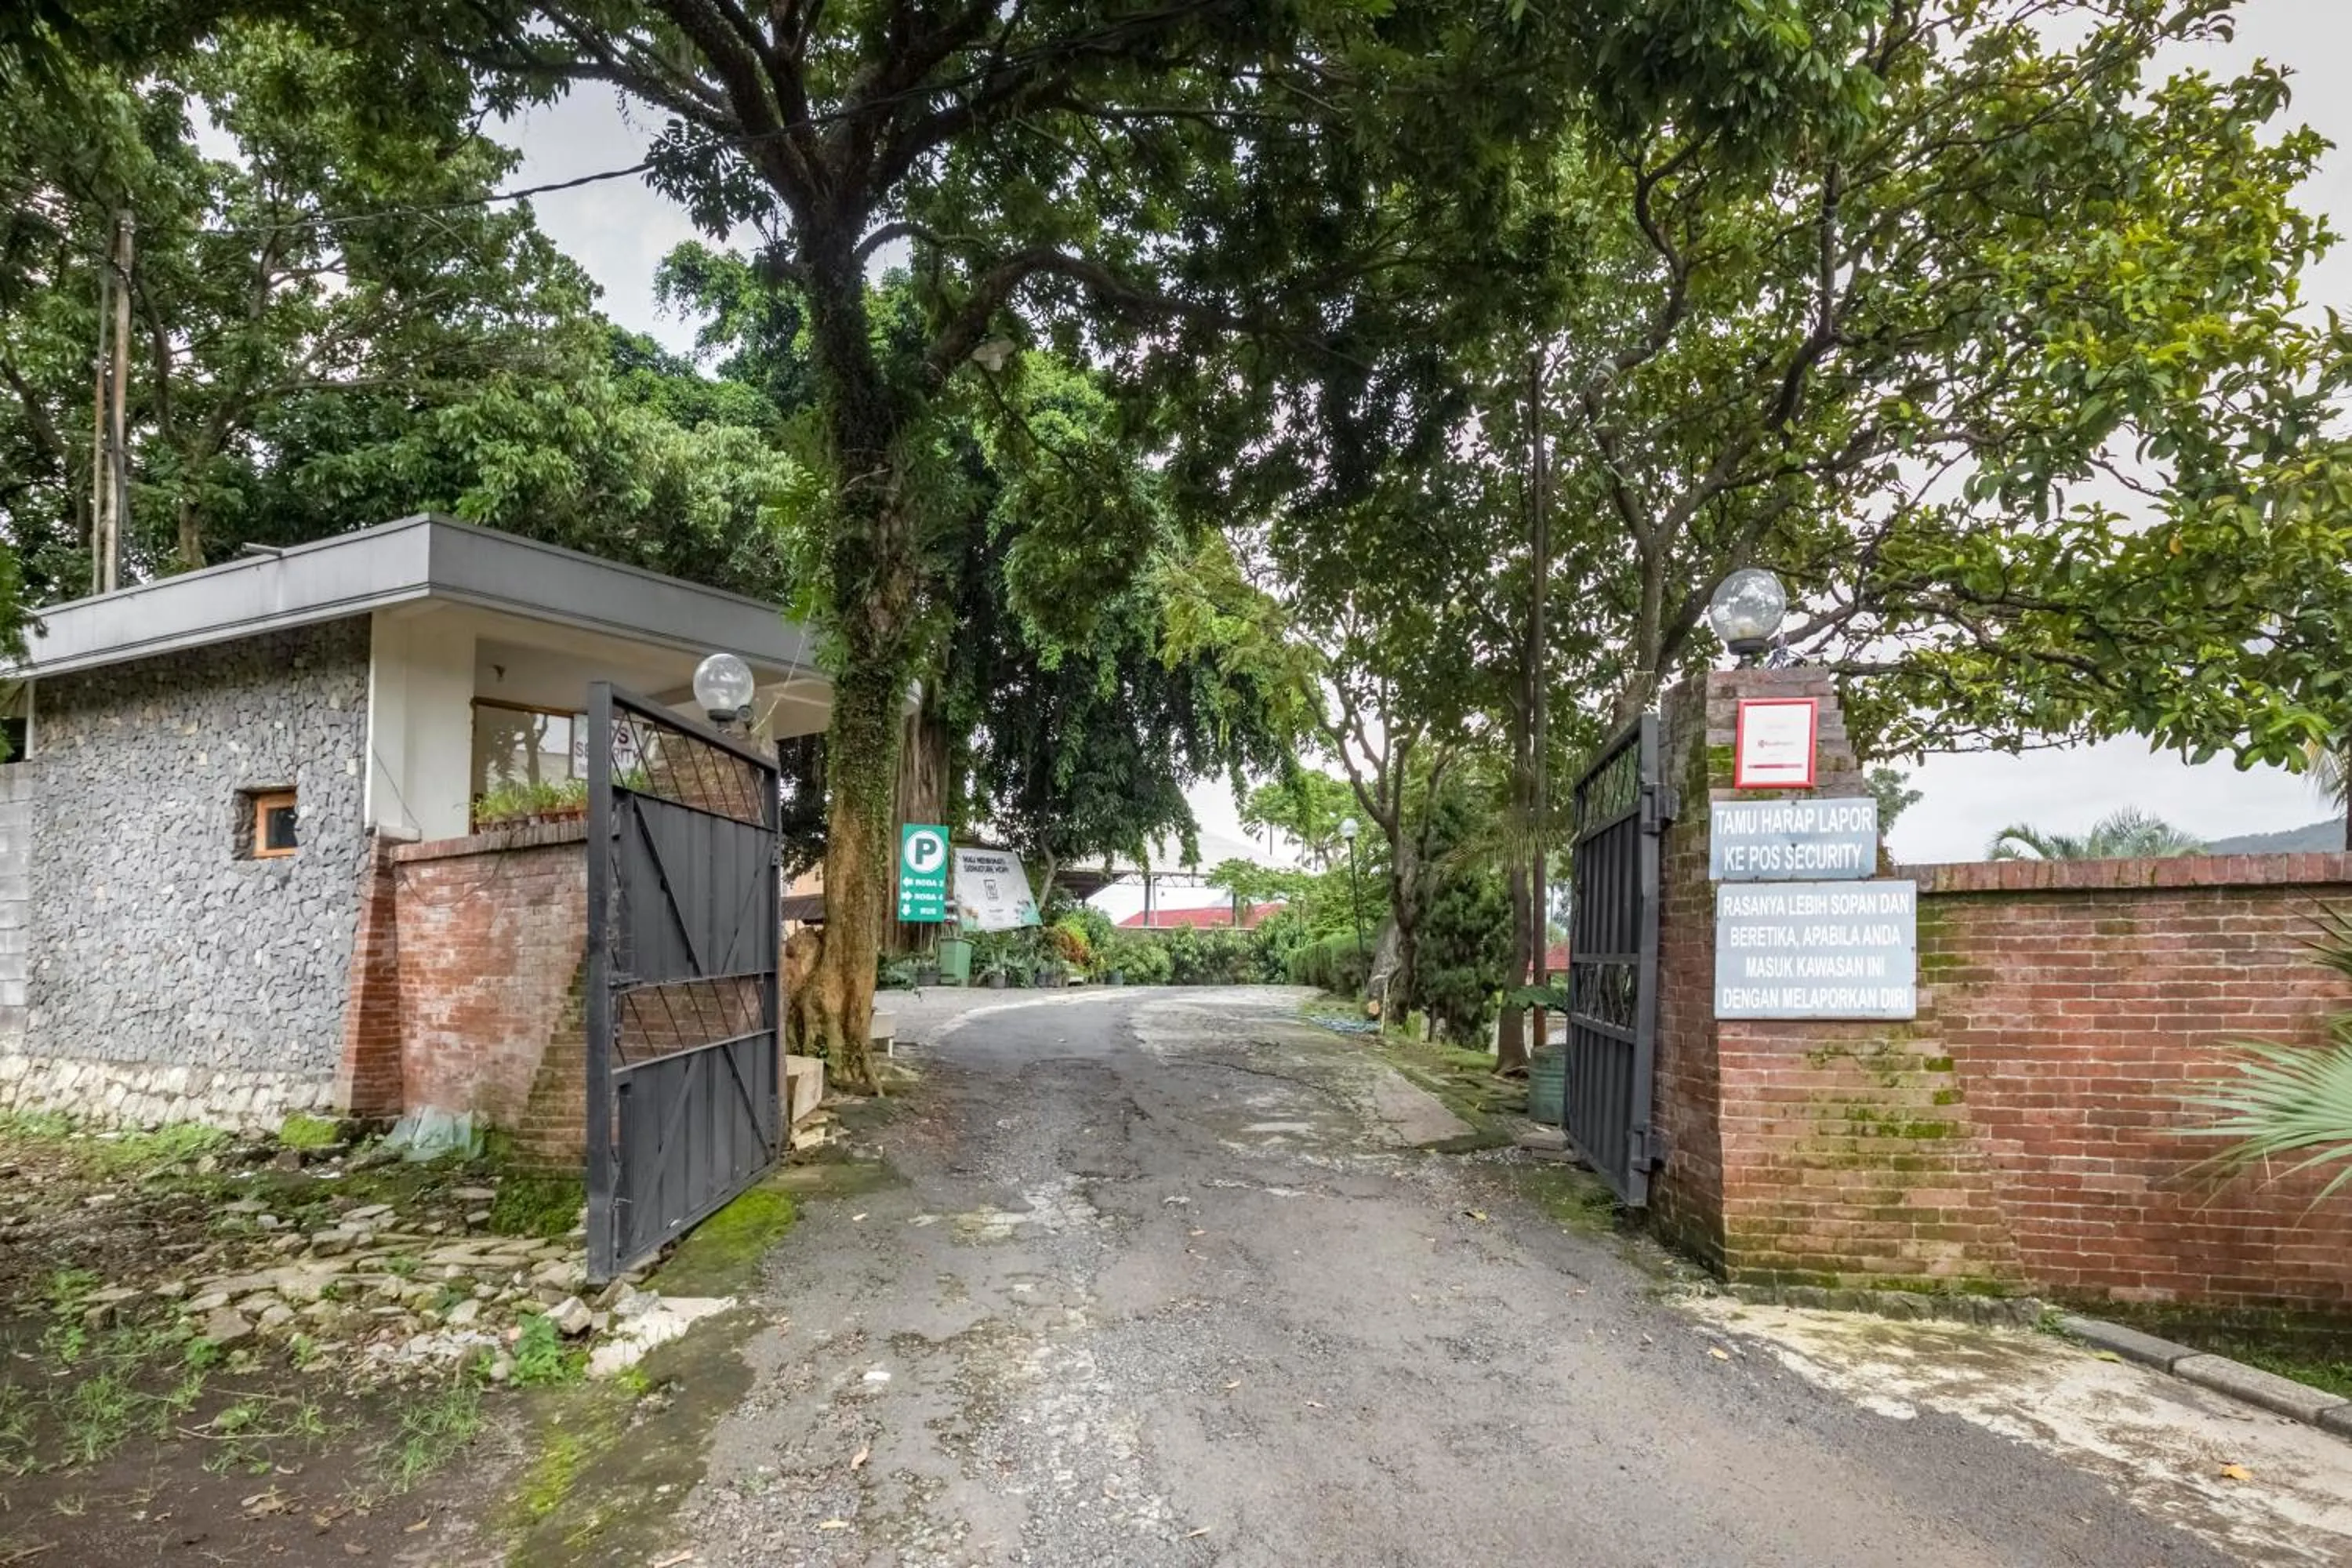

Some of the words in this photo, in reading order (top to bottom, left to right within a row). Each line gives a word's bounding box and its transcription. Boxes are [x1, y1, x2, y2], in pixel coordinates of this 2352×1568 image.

[1715, 810, 1757, 834] TAMU
[1762, 808, 1815, 833] HARAP
[1819, 807, 1873, 833] LAPOR
[915, 838, 937, 865] P
[1725, 846, 1745, 871] KE
[1749, 844, 1780, 871] POS
[1784, 843, 1863, 870] SECURITY
[1723, 895, 1786, 916] RASANYA
[1788, 895, 1828, 915] LEBIH
[1831, 894, 1876, 915] SOPAN
[1881, 893, 1909, 914] DAN
[1730, 926, 1799, 949] BERETIKA,
[1802, 925, 1860, 946] APABILA
[1862, 924, 1901, 946] ANDA
[1746, 956, 1795, 978] MASUK
[1796, 956, 1864, 978] KAWASAN
[1867, 956, 1885, 977] INI
[1723, 988, 1779, 1009] DENGAN
[1782, 987, 1877, 1009] MELAPORKAN
[1881, 987, 1907, 1008] DIRI
